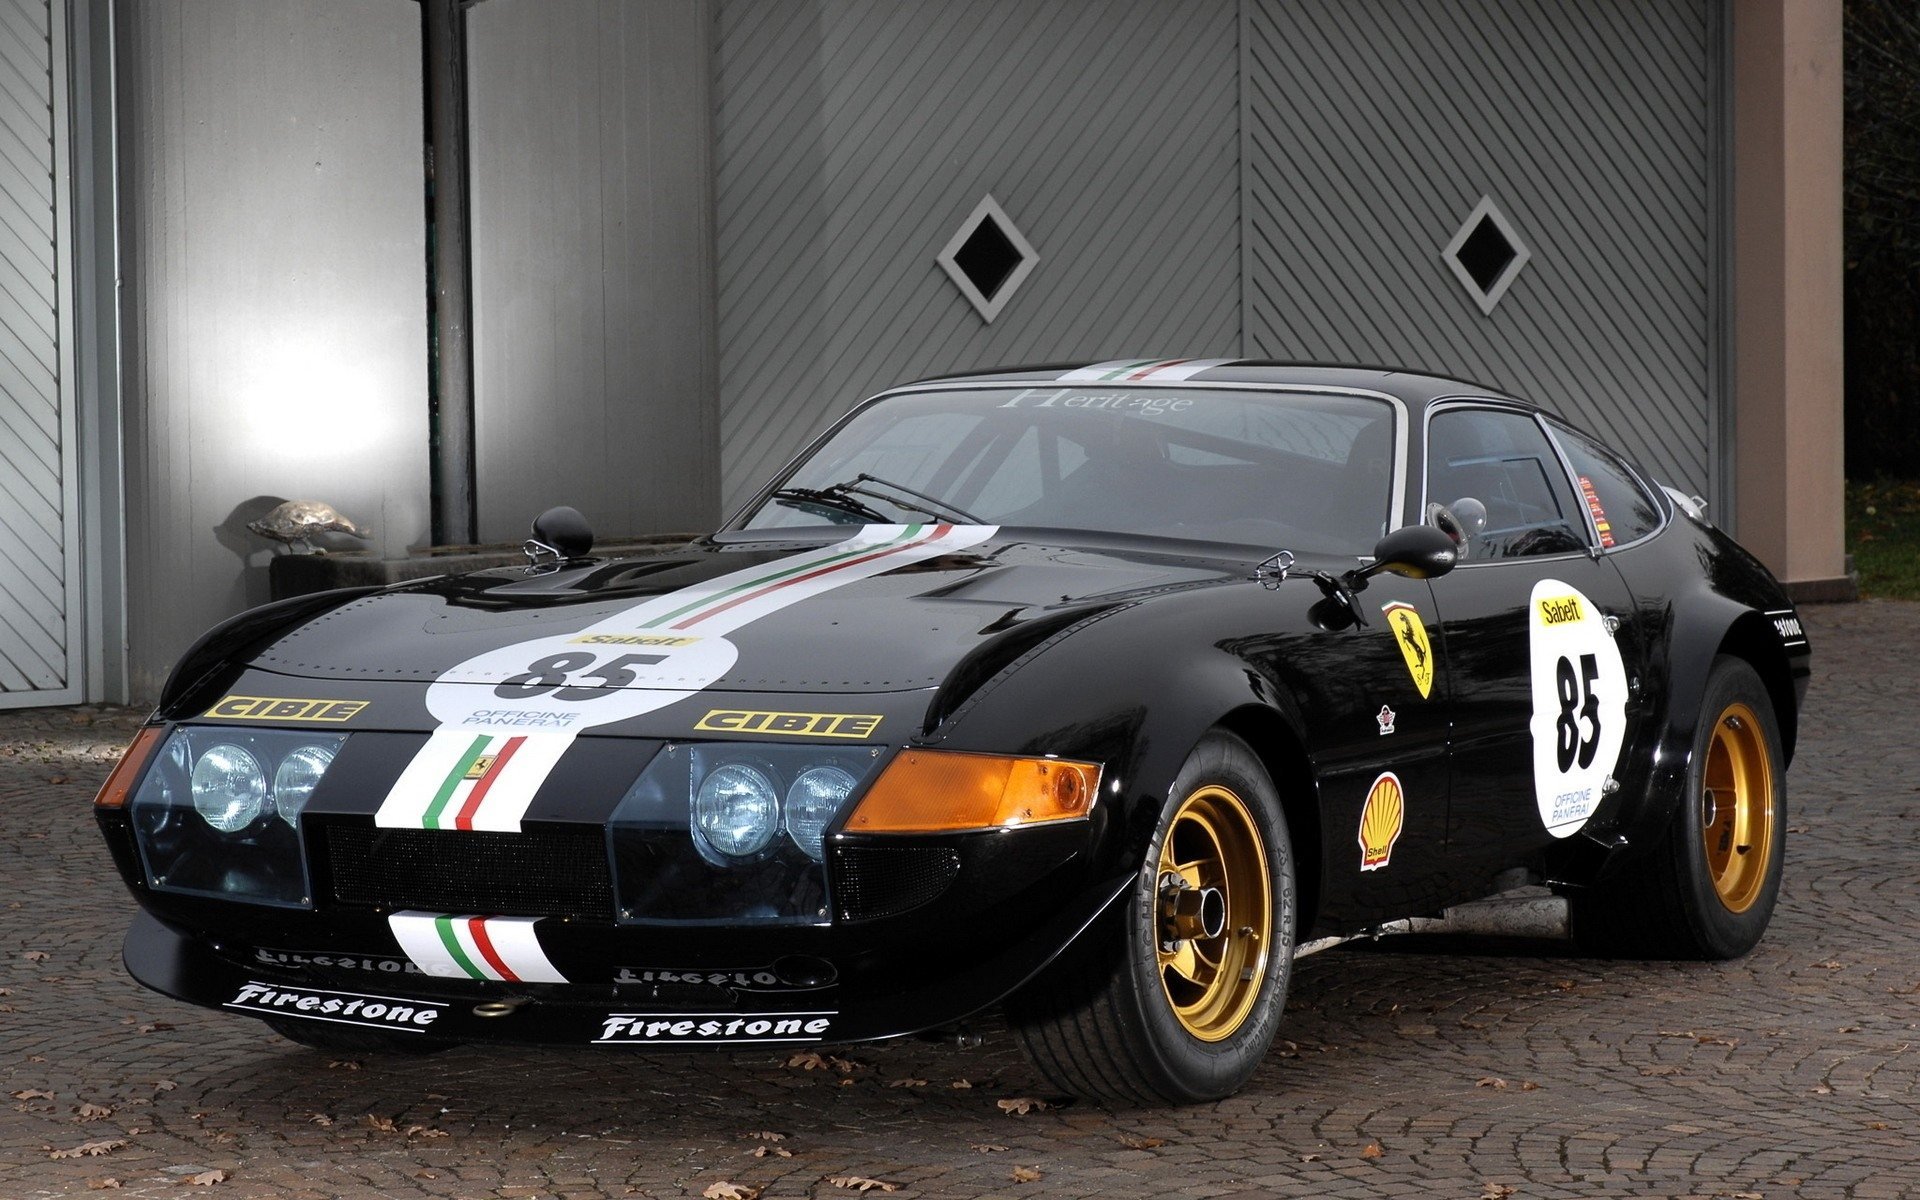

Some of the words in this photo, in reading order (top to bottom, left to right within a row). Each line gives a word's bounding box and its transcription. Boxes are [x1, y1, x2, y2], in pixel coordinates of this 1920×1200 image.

[996, 388, 1194, 416] Heritage
[1542, 599, 1581, 624] Sabelt
[581, 634, 687, 647] Sabelt
[494, 651, 670, 702] 85
[214, 698, 364, 719] CIBIE
[470, 709, 582, 721] OFFICINE
[1556, 653, 1601, 774] 85
[460, 715, 573, 728] PANERAI
[704, 712, 878, 735] CIBIE
[1554, 788, 1592, 809] OFFICINE
[1552, 803, 1590, 823] PANERAI
[1367, 845, 1388, 858] Shell
[231, 983, 438, 1026] Firestone
[600, 1016, 831, 1040] Firestone
